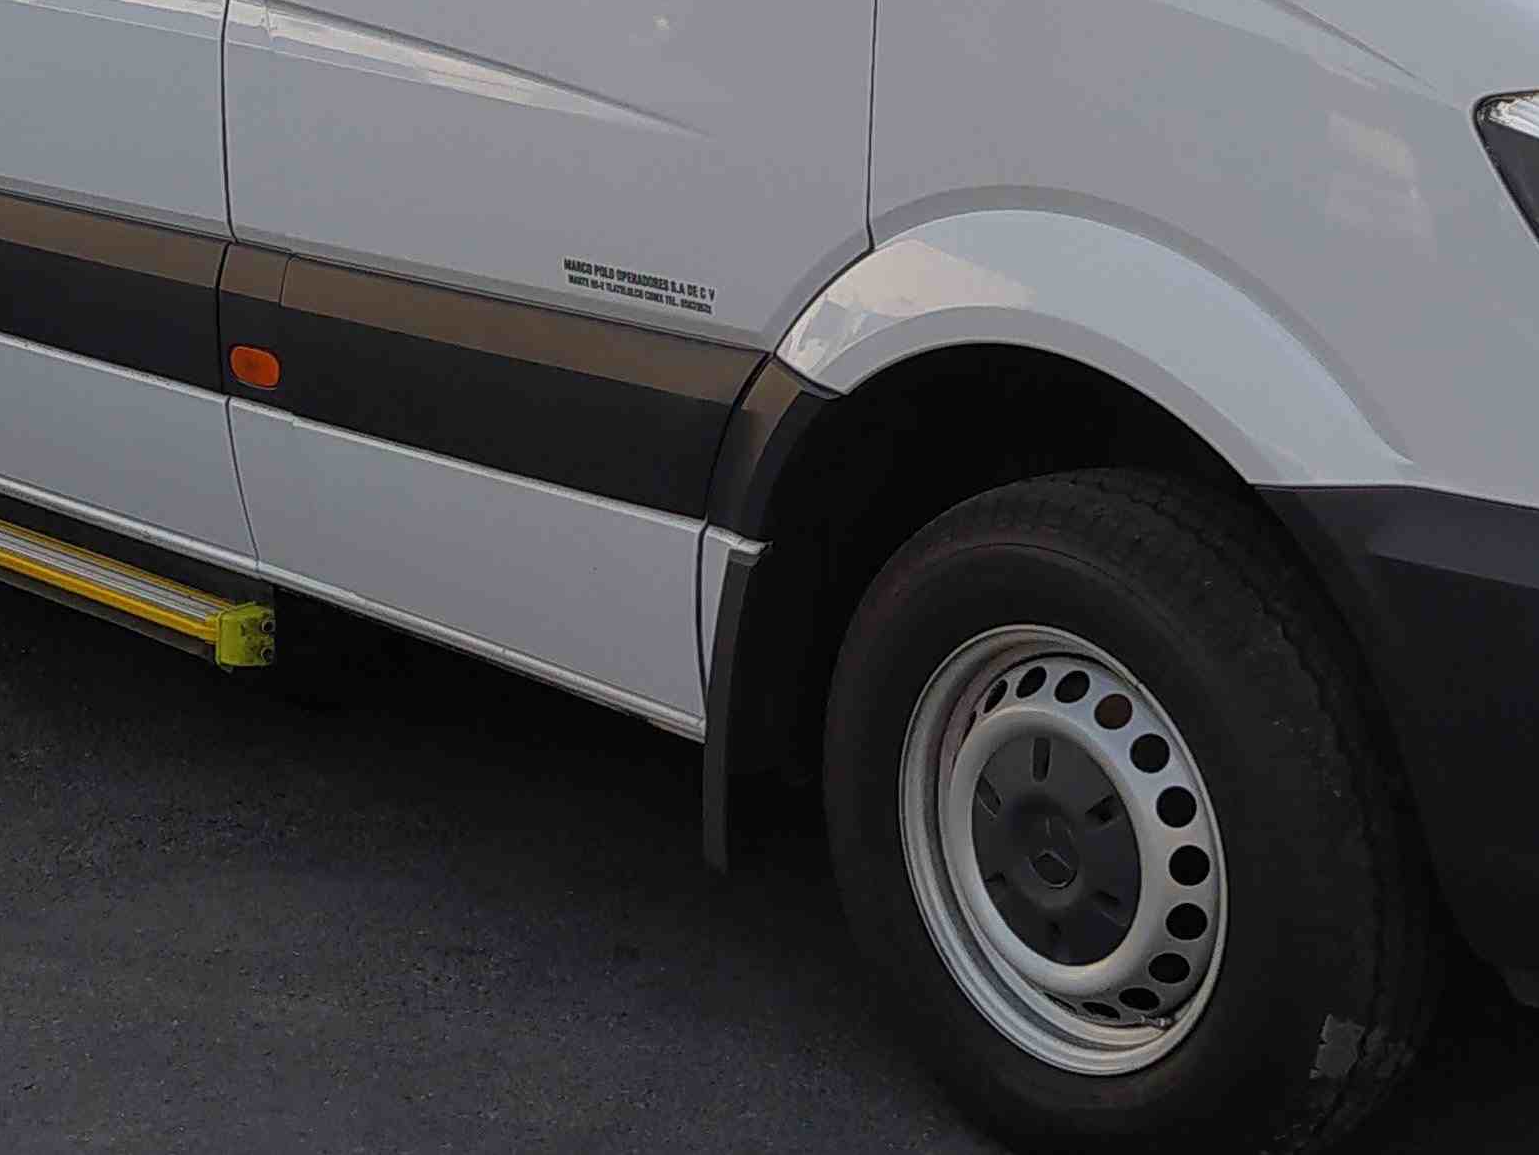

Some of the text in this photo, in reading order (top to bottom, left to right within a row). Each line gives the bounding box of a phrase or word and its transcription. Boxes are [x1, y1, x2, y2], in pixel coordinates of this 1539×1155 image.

[564, 258, 592, 275] MARCO
[594, 264, 614, 279] POLO
[617, 269, 668, 291] OPERADORES
[687, 284, 698, 298] DE
